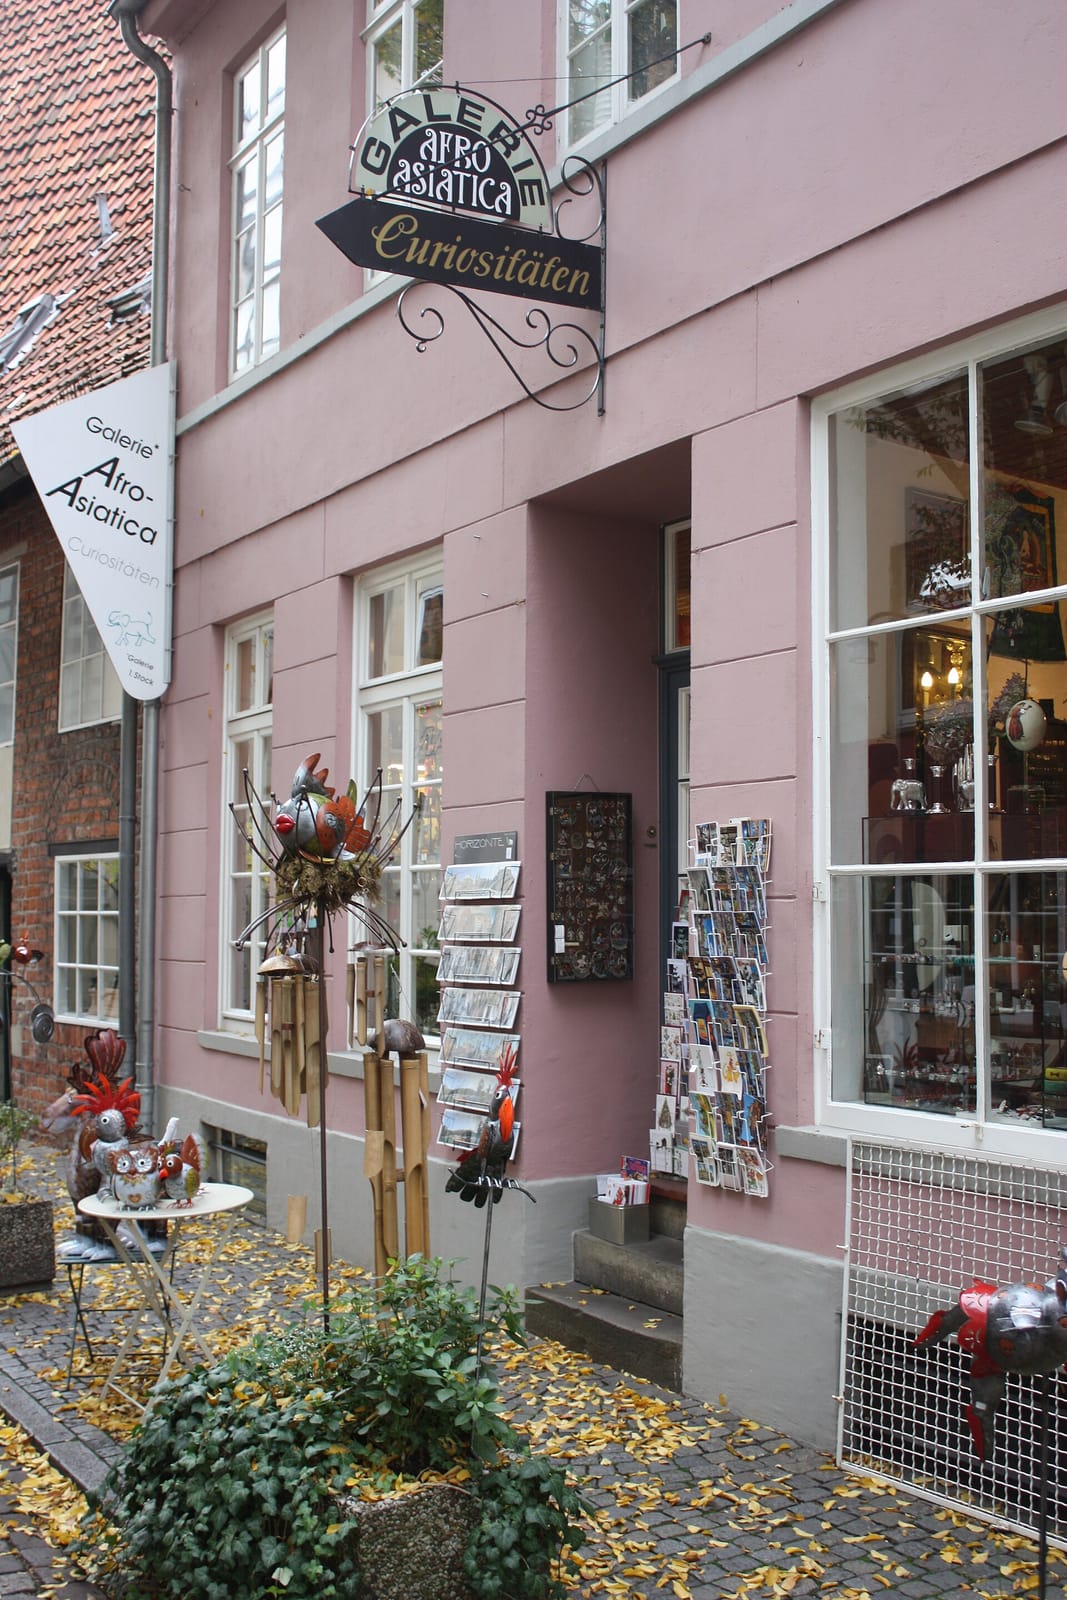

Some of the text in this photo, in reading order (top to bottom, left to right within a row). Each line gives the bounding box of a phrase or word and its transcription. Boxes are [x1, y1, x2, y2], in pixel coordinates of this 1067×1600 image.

[361, 93, 546, 206] GALERIE
[419, 127, 491, 173] AFRO
[393, 158, 512, 216] ASIATICA
[371, 214, 590, 296] Curiositäten
[82, 456, 154, 505] Afro-
[45, 476, 158, 546] Asiatica
[67, 536, 160, 589] Curiositäten
